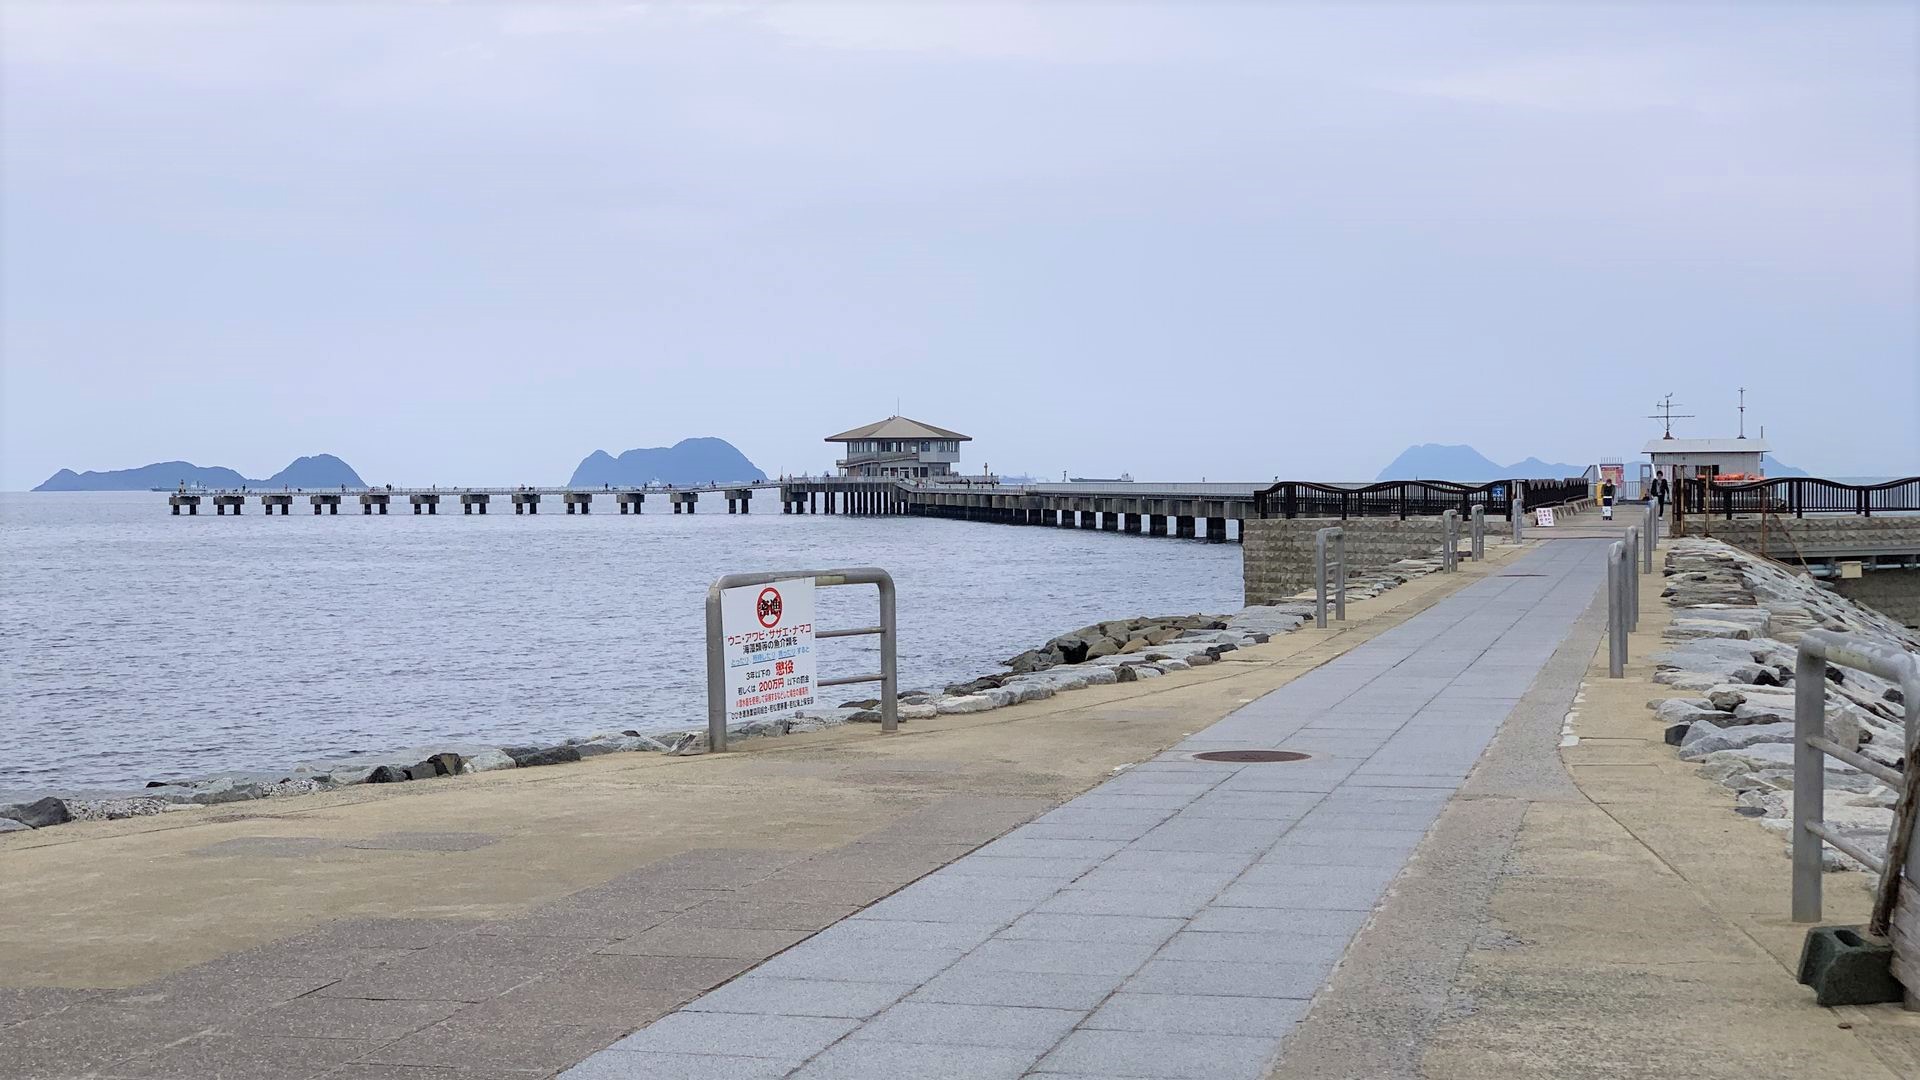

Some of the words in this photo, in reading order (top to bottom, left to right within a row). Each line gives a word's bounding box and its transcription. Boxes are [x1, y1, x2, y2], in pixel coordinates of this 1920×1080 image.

[727, 623, 812, 647] ウニ・アワビ・サザエ・ナマコ
[758, 677, 785, 693] 200万円
